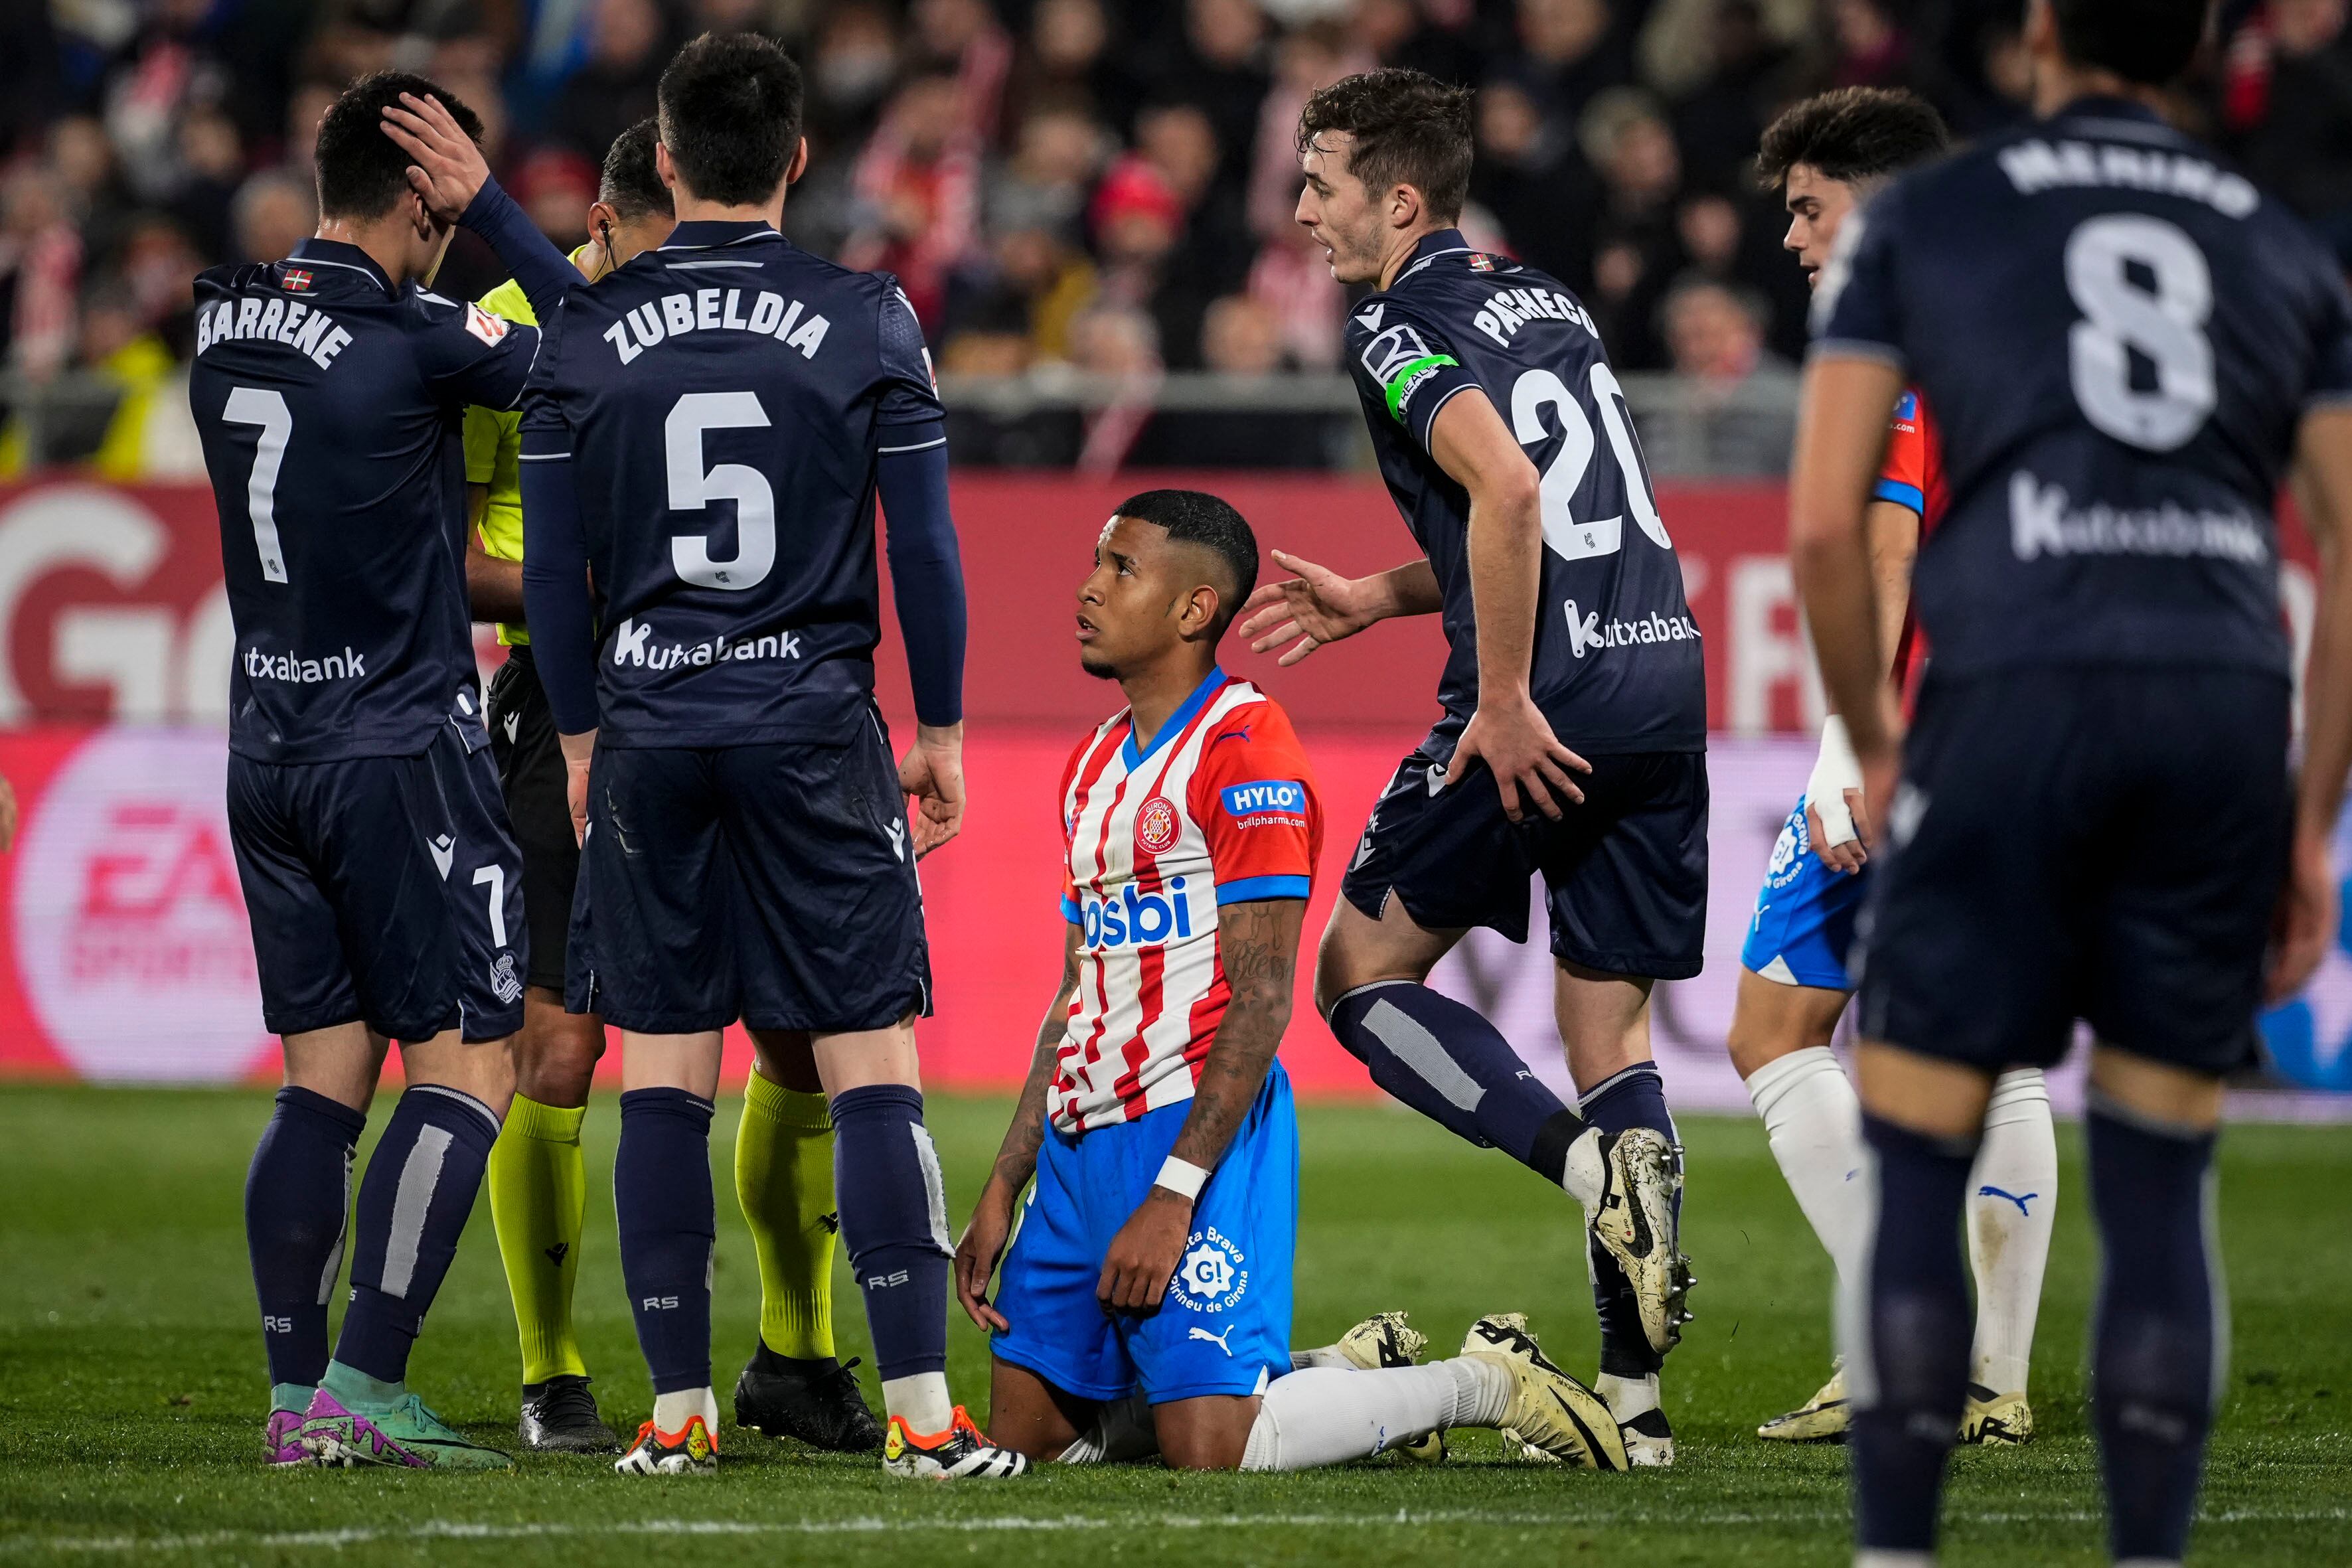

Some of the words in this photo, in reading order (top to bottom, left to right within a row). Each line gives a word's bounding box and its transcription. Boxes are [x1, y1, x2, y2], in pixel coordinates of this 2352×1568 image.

[197, 298, 353, 370] BARRENE
[603, 288, 830, 365] ZUBELDIA
[1474, 287, 1599, 349] PACHECO
[2065, 213, 2217, 452] 8
[1512, 362, 1672, 561] 20
[222, 387, 293, 584] 7
[665, 391, 776, 590] 5
[614, 617, 799, 670] Kutxabank
[1146, 802, 1172, 817] GIRONA
[1237, 815, 1305, 830] brillpharma.com
[1158, 840, 1171, 849] CLUB
[1772, 861, 1803, 889] Girona
[473, 864, 507, 948] 7
[1081, 876, 1191, 949] osbi
[1206, 1226, 1245, 1263] Brava
[868, 1270, 909, 1290] RS
[1196, 1261, 1222, 1284] G!
[1206, 1301, 1222, 1313] de
[1223, 1271, 1248, 1308] Girona
[264, 1316, 291, 1333] RS
[644, 1296, 678, 1311] RS
